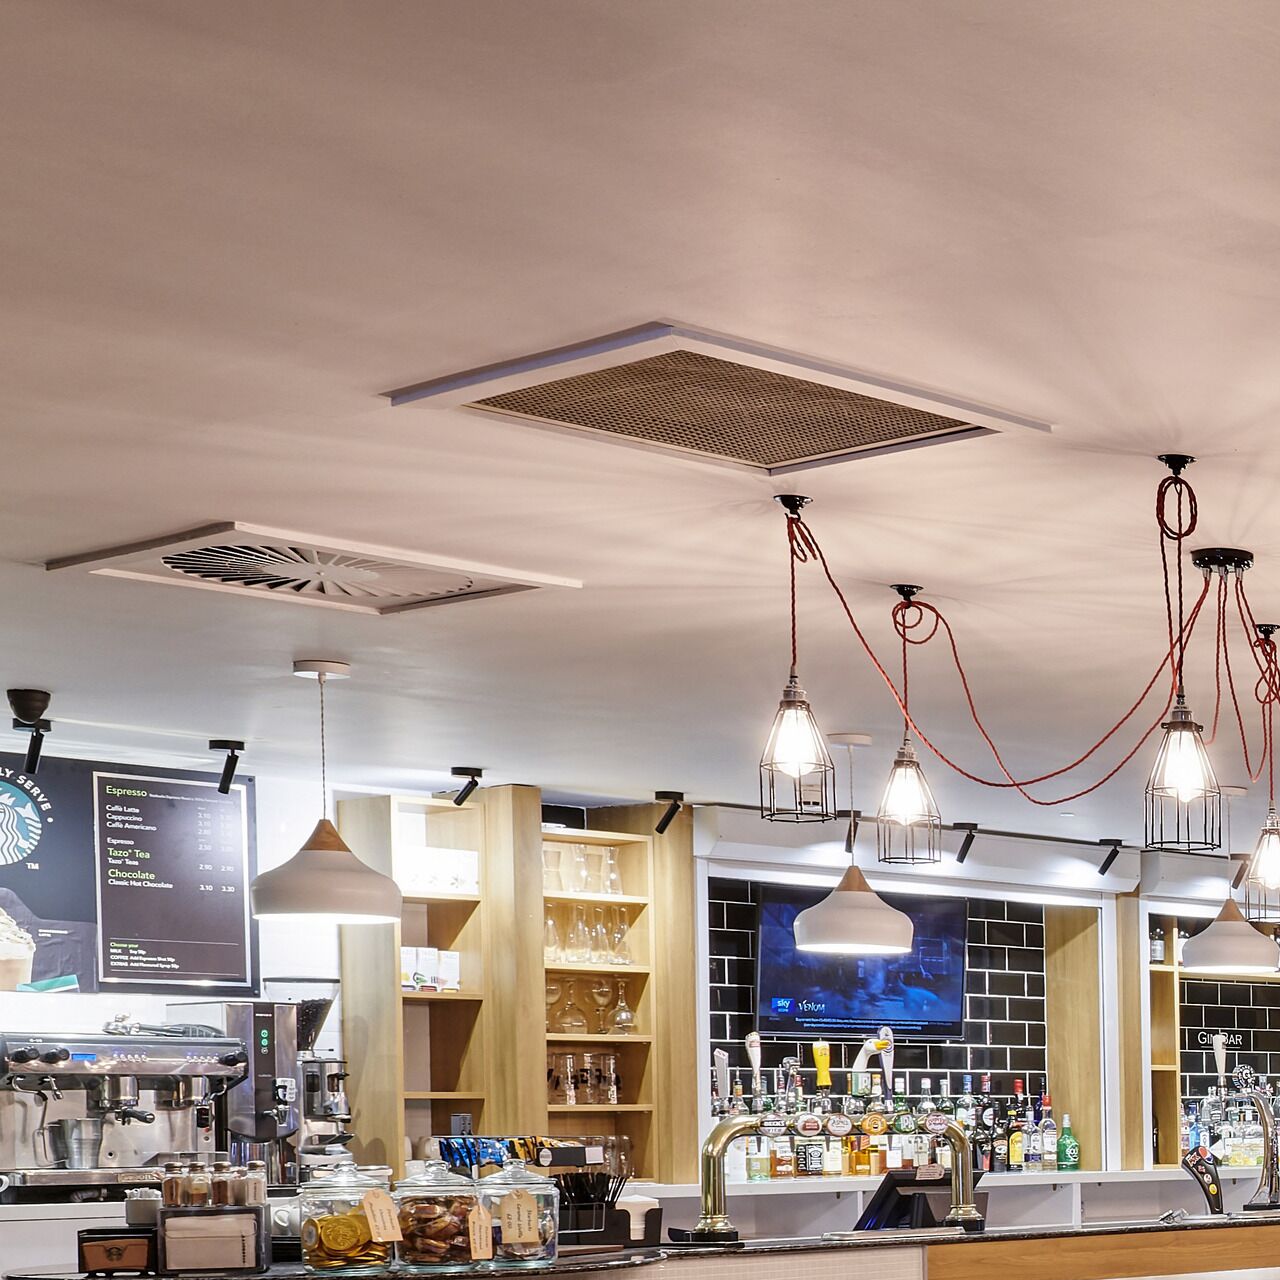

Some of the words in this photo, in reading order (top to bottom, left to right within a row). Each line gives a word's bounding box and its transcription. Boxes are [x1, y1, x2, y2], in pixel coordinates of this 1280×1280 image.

[16, 775, 52, 811] SERVE
[106, 785, 148, 797] Espresso
[107, 837, 135, 845] Espresso
[133, 849, 151, 859] Tea
[108, 868, 156, 880] Chocolate
[142, 881, 173, 889] Chocolate
[777, 999, 791, 1009] sky
[798, 1000, 825, 1013] VENOM
[1197, 1031, 1214, 1045] GI
